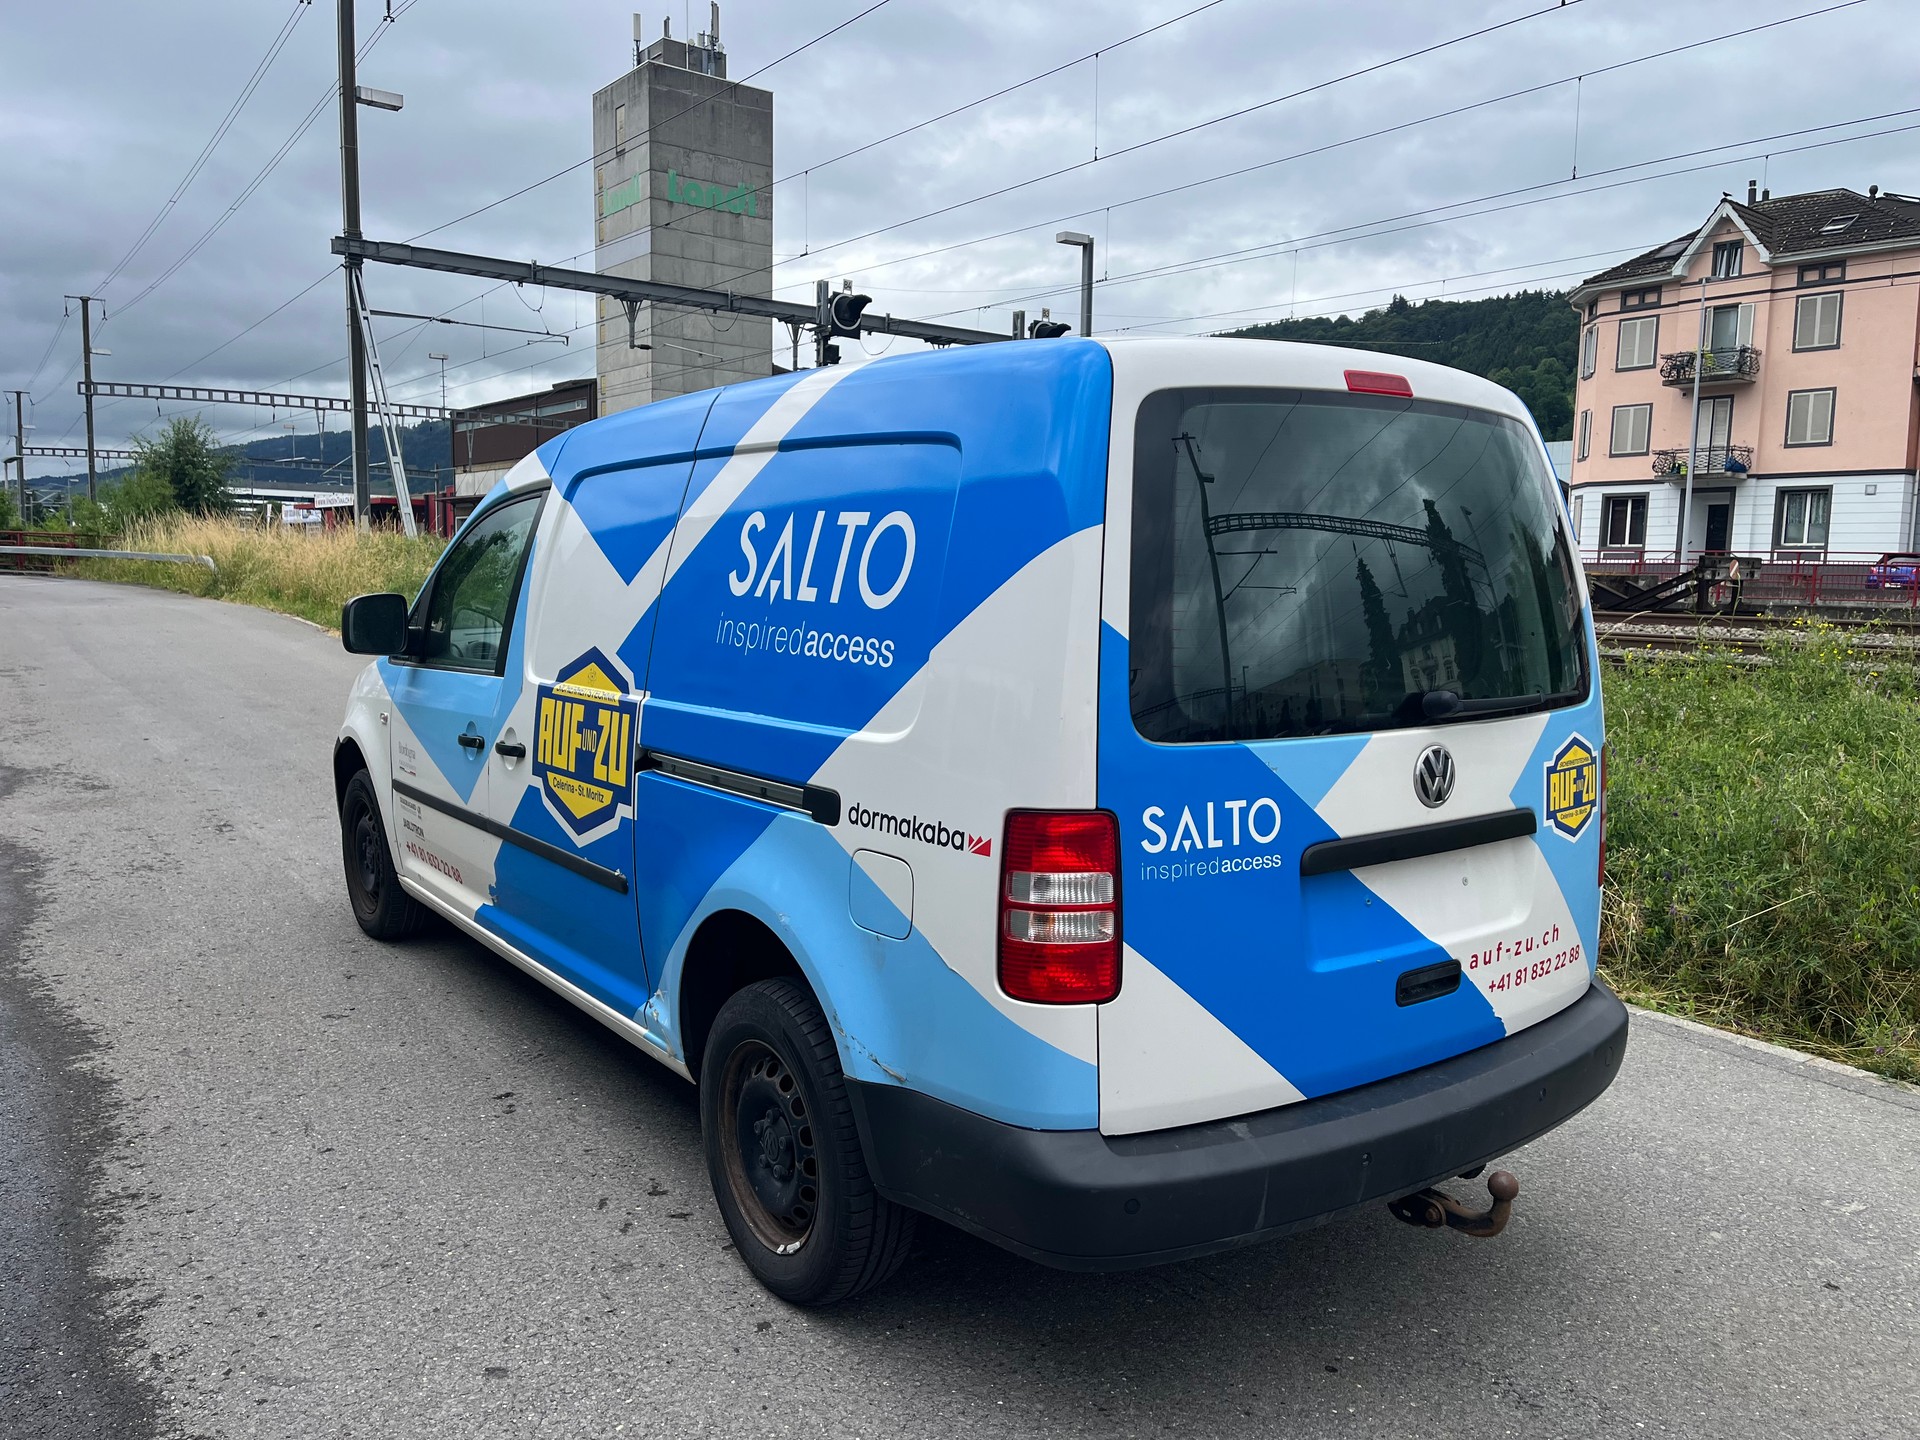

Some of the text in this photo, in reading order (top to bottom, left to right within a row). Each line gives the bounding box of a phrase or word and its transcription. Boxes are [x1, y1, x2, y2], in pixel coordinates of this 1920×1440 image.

[667, 168, 757, 217] Landi
[728, 510, 916, 610] SALTO
[716, 611, 895, 668] inspiredaccess
[537, 696, 630, 788] AUF UND ZU
[552, 777, 575, 793] Celerina
[586, 789, 604, 803] Moritz
[1549, 764, 1596, 812] AUF ZU
[848, 802, 965, 851] dormakaba
[1140, 797, 1282, 854] SALTO
[406, 841, 463, 884] +41 81 832 22 88
[1140, 854, 1282, 882] inspiredaccess
[1469, 924, 1560, 970] auf-zu.ch
[1488, 944, 1580, 993] +41 81 832 22 88
